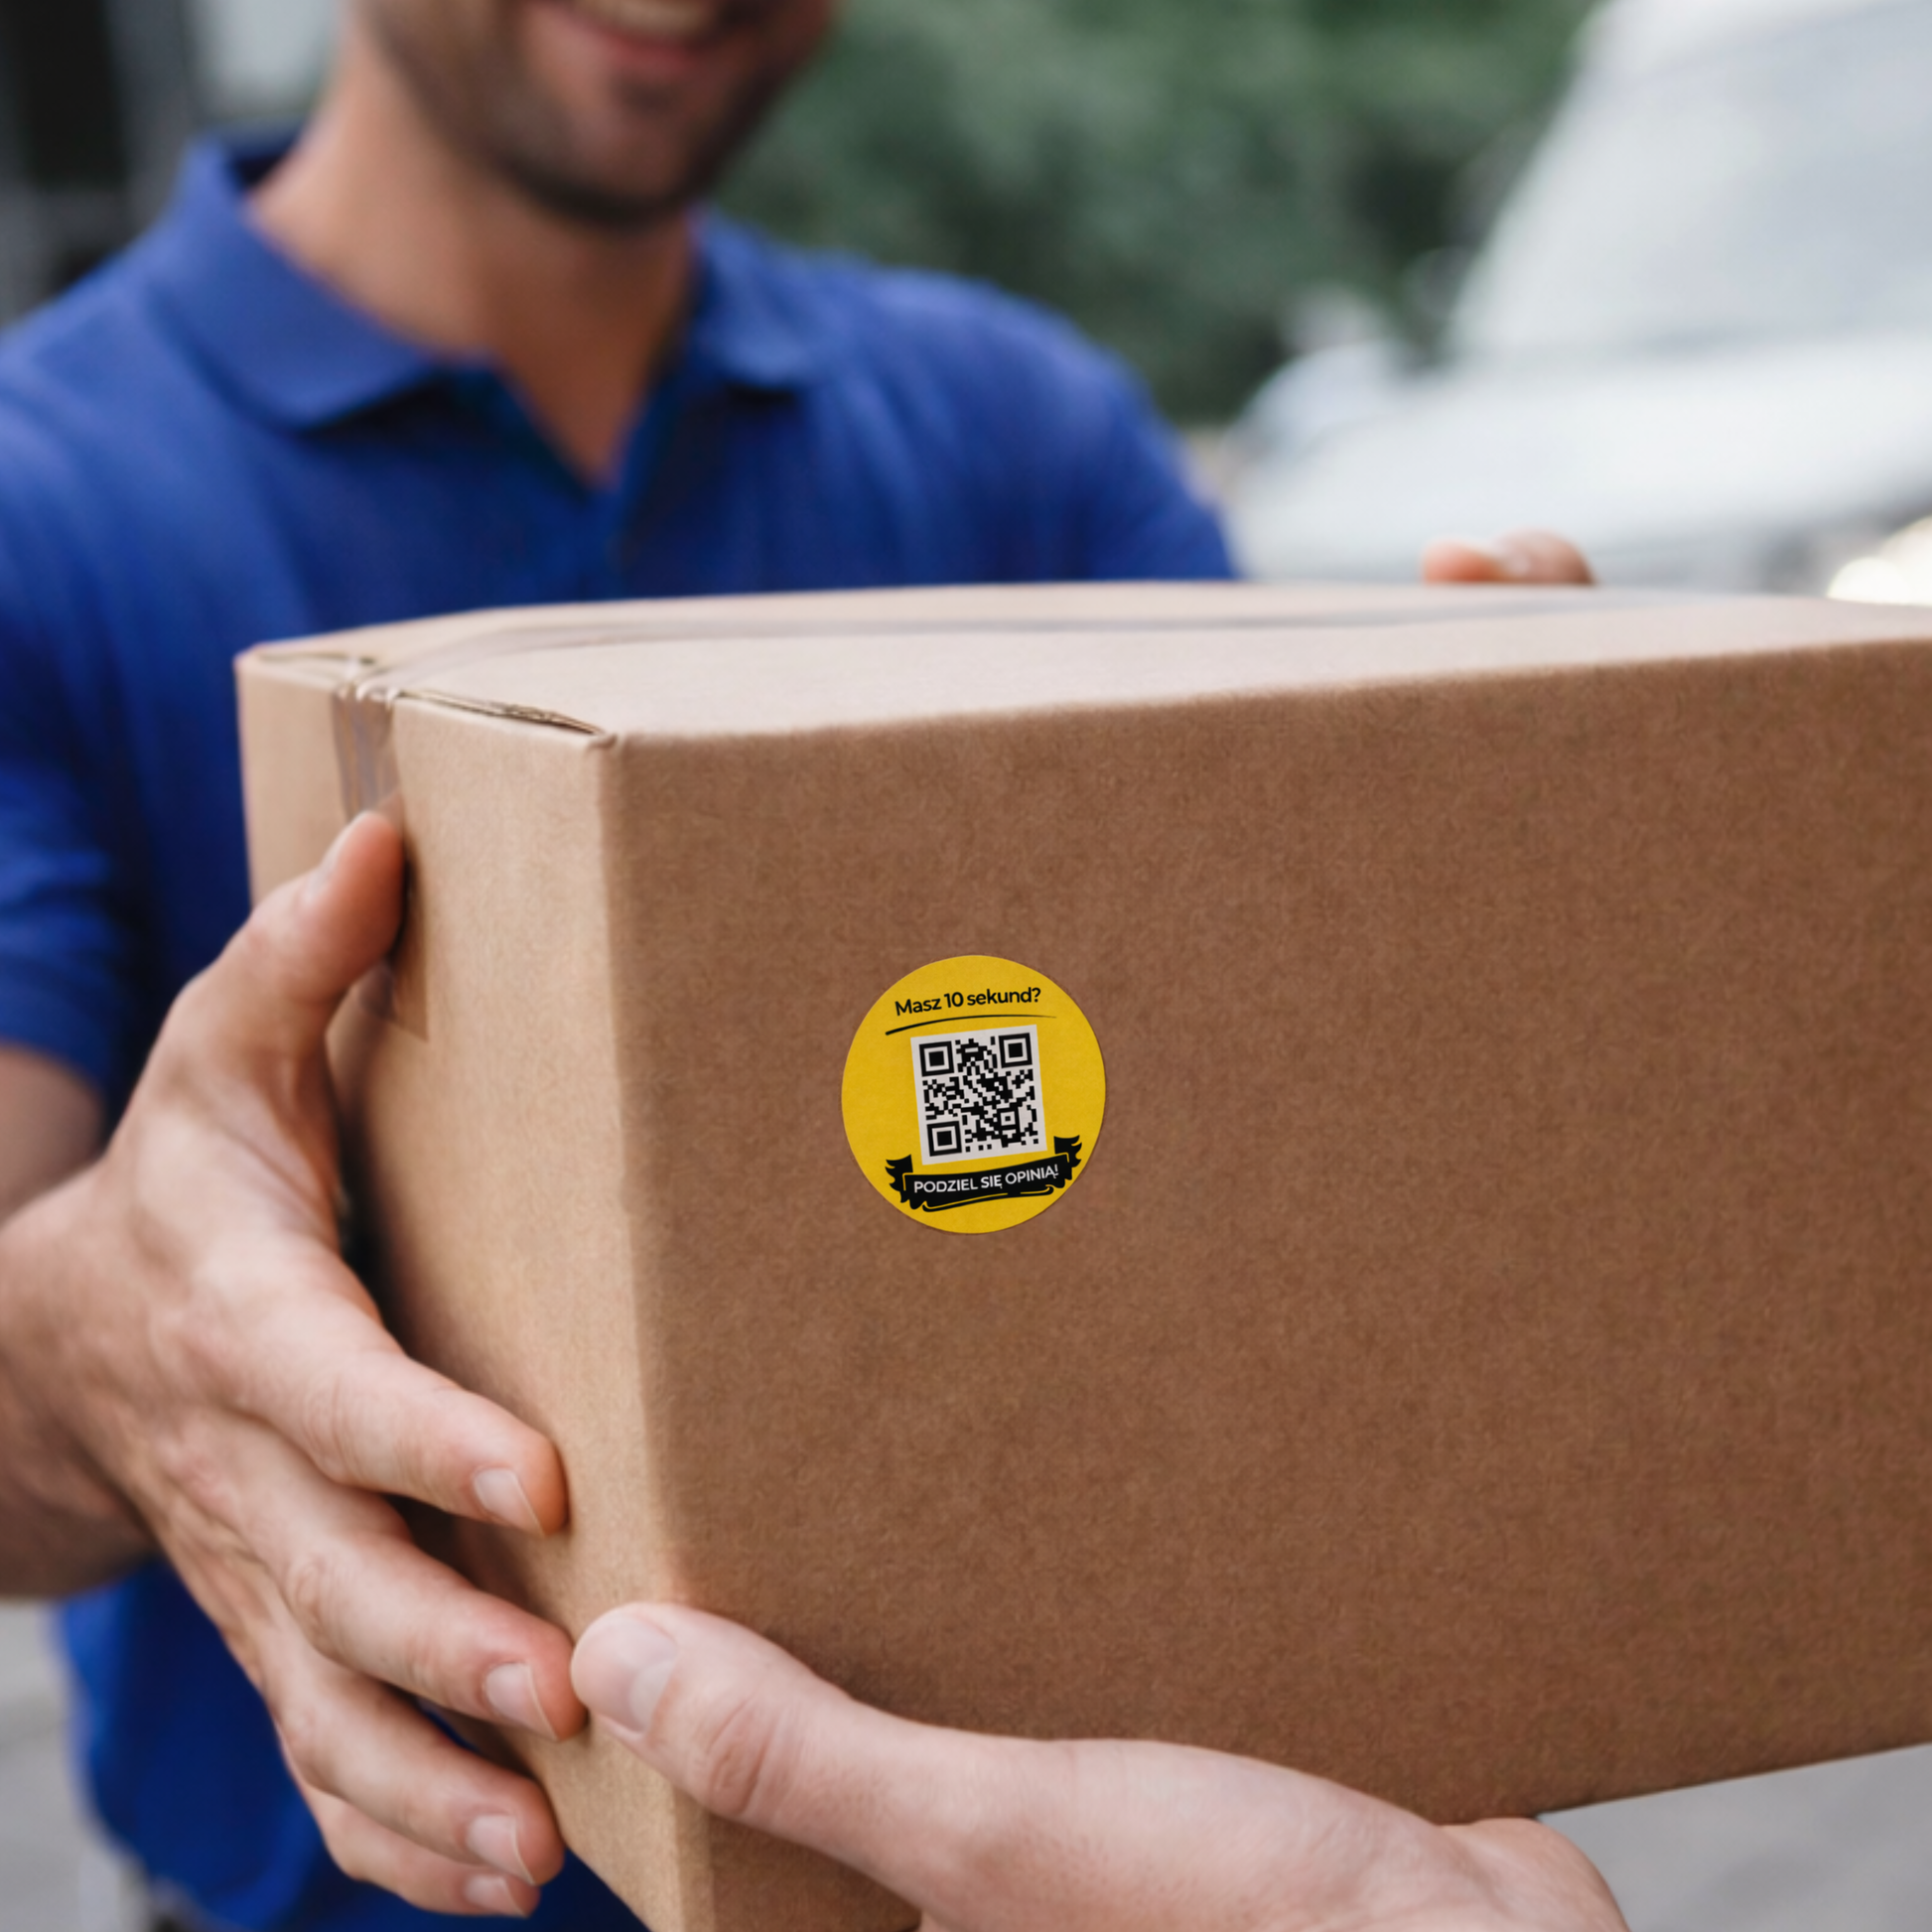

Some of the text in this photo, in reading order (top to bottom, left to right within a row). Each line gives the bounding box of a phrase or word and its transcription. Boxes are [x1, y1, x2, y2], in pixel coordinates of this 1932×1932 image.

[895, 987, 1041, 1017] Masz 10 sekund?
[913, 1164, 1059, 1193] PODZIEL SIĘ OPINIĄ!
